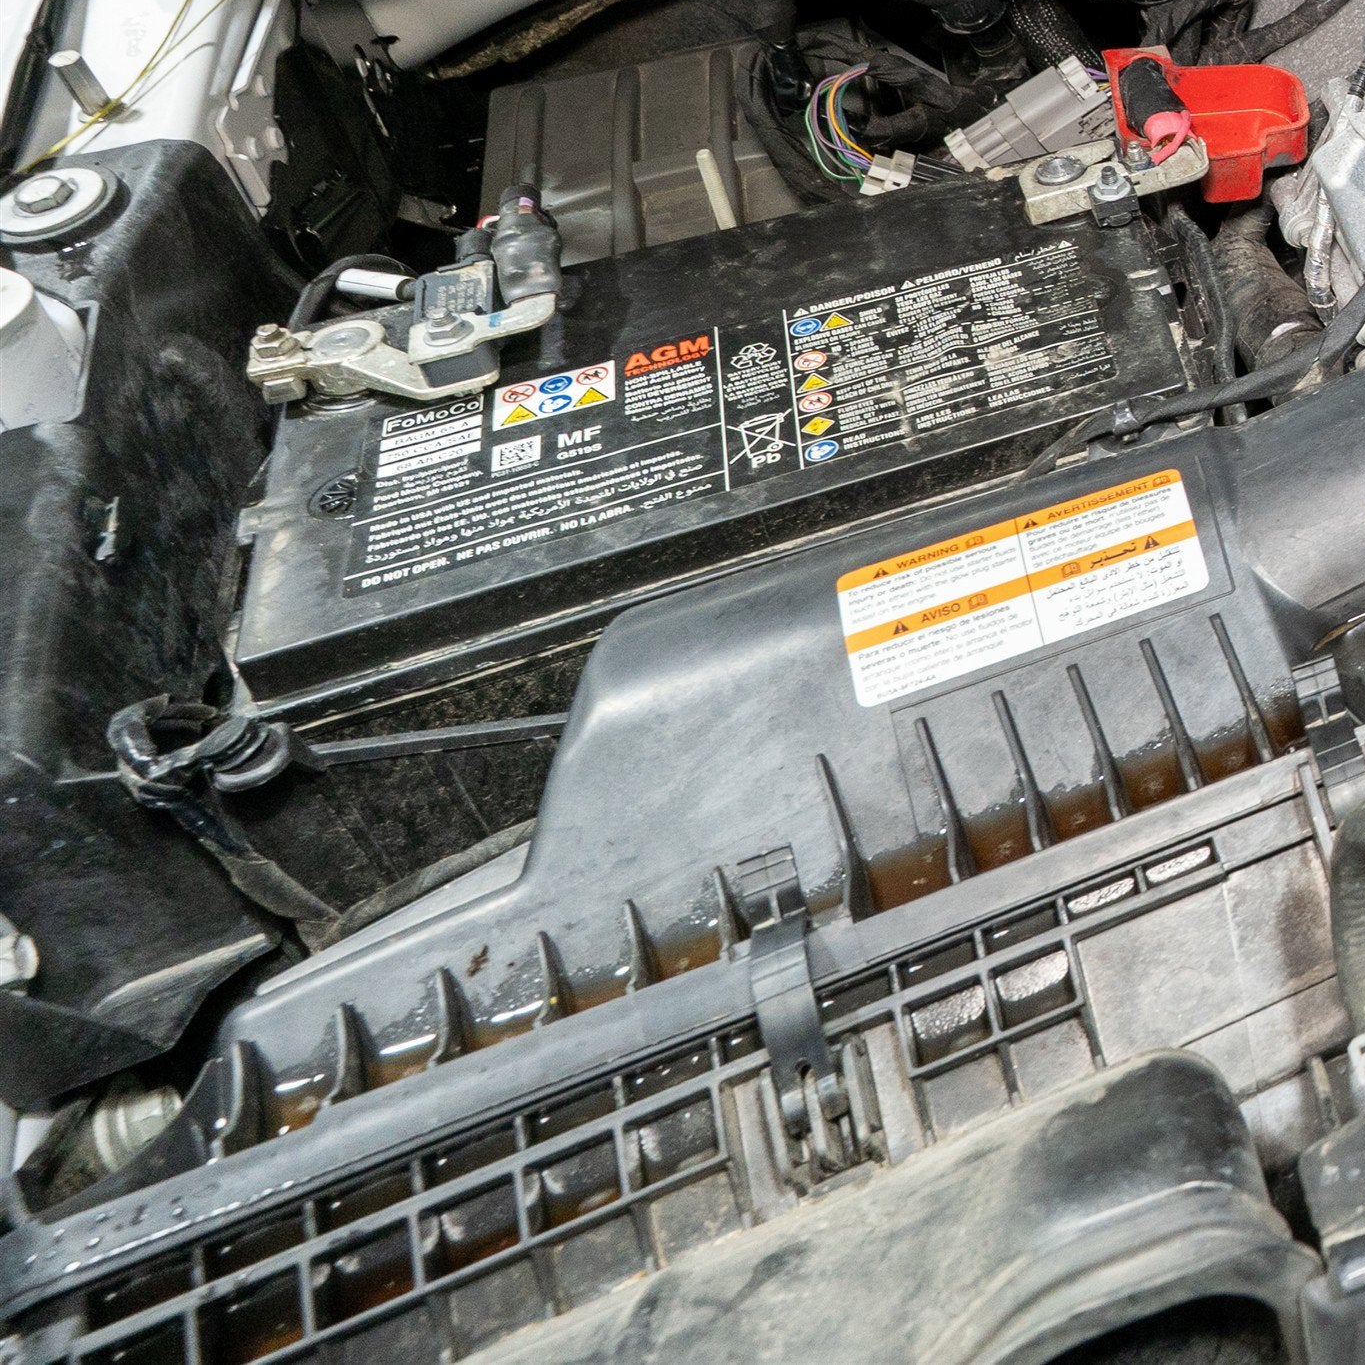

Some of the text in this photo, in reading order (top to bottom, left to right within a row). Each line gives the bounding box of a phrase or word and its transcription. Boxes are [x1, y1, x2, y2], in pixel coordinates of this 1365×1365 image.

[914, 257, 1003, 286] PELIGRO/VENENO
[808, 285, 896, 313] DANGER/POISON
[620, 333, 711, 370] AGM
[623, 350, 710, 377] TECHNOLOGY
[623, 360, 702, 385] NON-SPILLABLE
[671, 365, 705, 378] Battery
[384, 397, 480, 432] FoMoCo
[623, 396, 662, 411] CONTRA
[555, 424, 604, 449] MF
[677, 462, 704, 477] صنع
[750, 451, 782, 468] Pb
[372, 482, 431, 503] Ford Motor
[574, 486, 616, 506] المتحدة
[616, 473, 663, 493] الولايات
[674, 482, 713, 500] ممنوع
[368, 519, 398, 532] Made
[490, 480, 535, 498] imported
[1045, 481, 1150, 520] AVERTISSEMENT
[1090, 504, 1117, 517] risque
[1130, 487, 1171, 503] blessures
[382, 567, 411, 582] NOT
[411, 556, 450, 574] OPEN.
[474, 541, 501, 555] PAS
[502, 525, 554, 547] OUVRIR.
[597, 503, 635, 520] ABRA.
[1027, 531, 1056, 546] graves
[895, 543, 959, 569] WARNING
[1086, 541, 1138, 568] تحذير
[847, 592, 874, 607] injury
[966, 553, 992, 567] starter
[859, 578, 892, 593] reduce
[923, 554, 962, 572] possible
[963, 543, 997, 558] serious
[919, 601, 962, 623] AVISO
[881, 635, 915, 652] reducir
[927, 621, 958, 638] riesgo
[972, 603, 1011, 621] lesiones
[860, 654, 896, 671] severas
